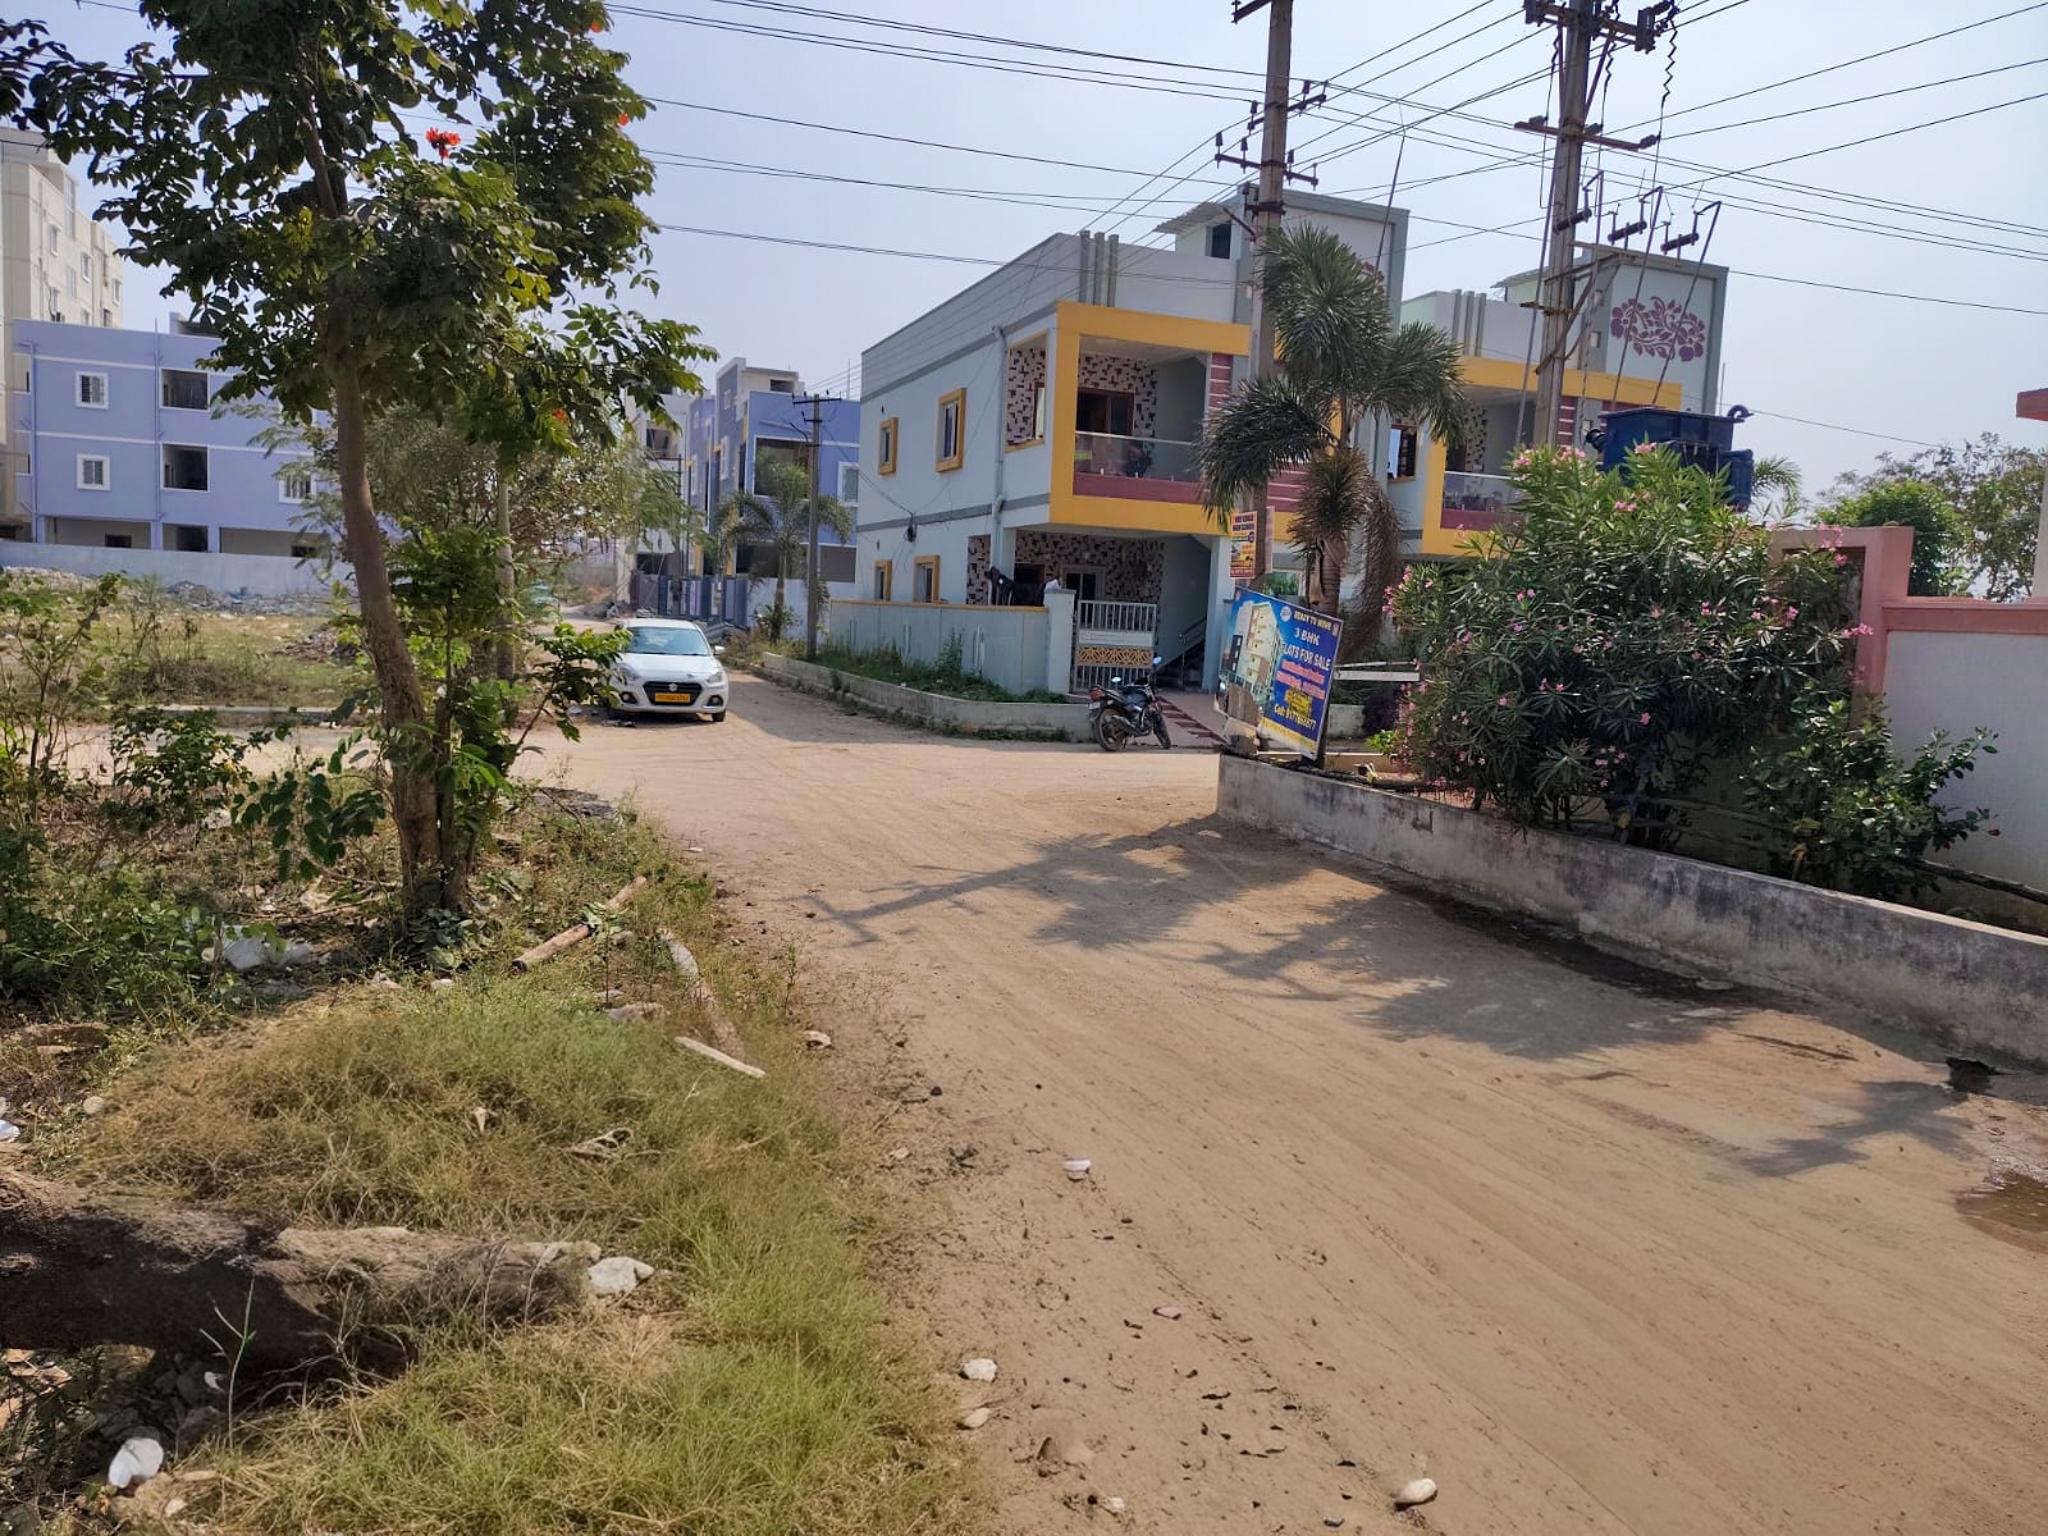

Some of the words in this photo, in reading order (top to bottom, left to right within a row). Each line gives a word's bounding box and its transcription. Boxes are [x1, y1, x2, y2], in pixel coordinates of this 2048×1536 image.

[1301, 630, 1320, 646] BHK
[1300, 648, 1314, 664] FOR
[1314, 654, 1332, 670] SALE
